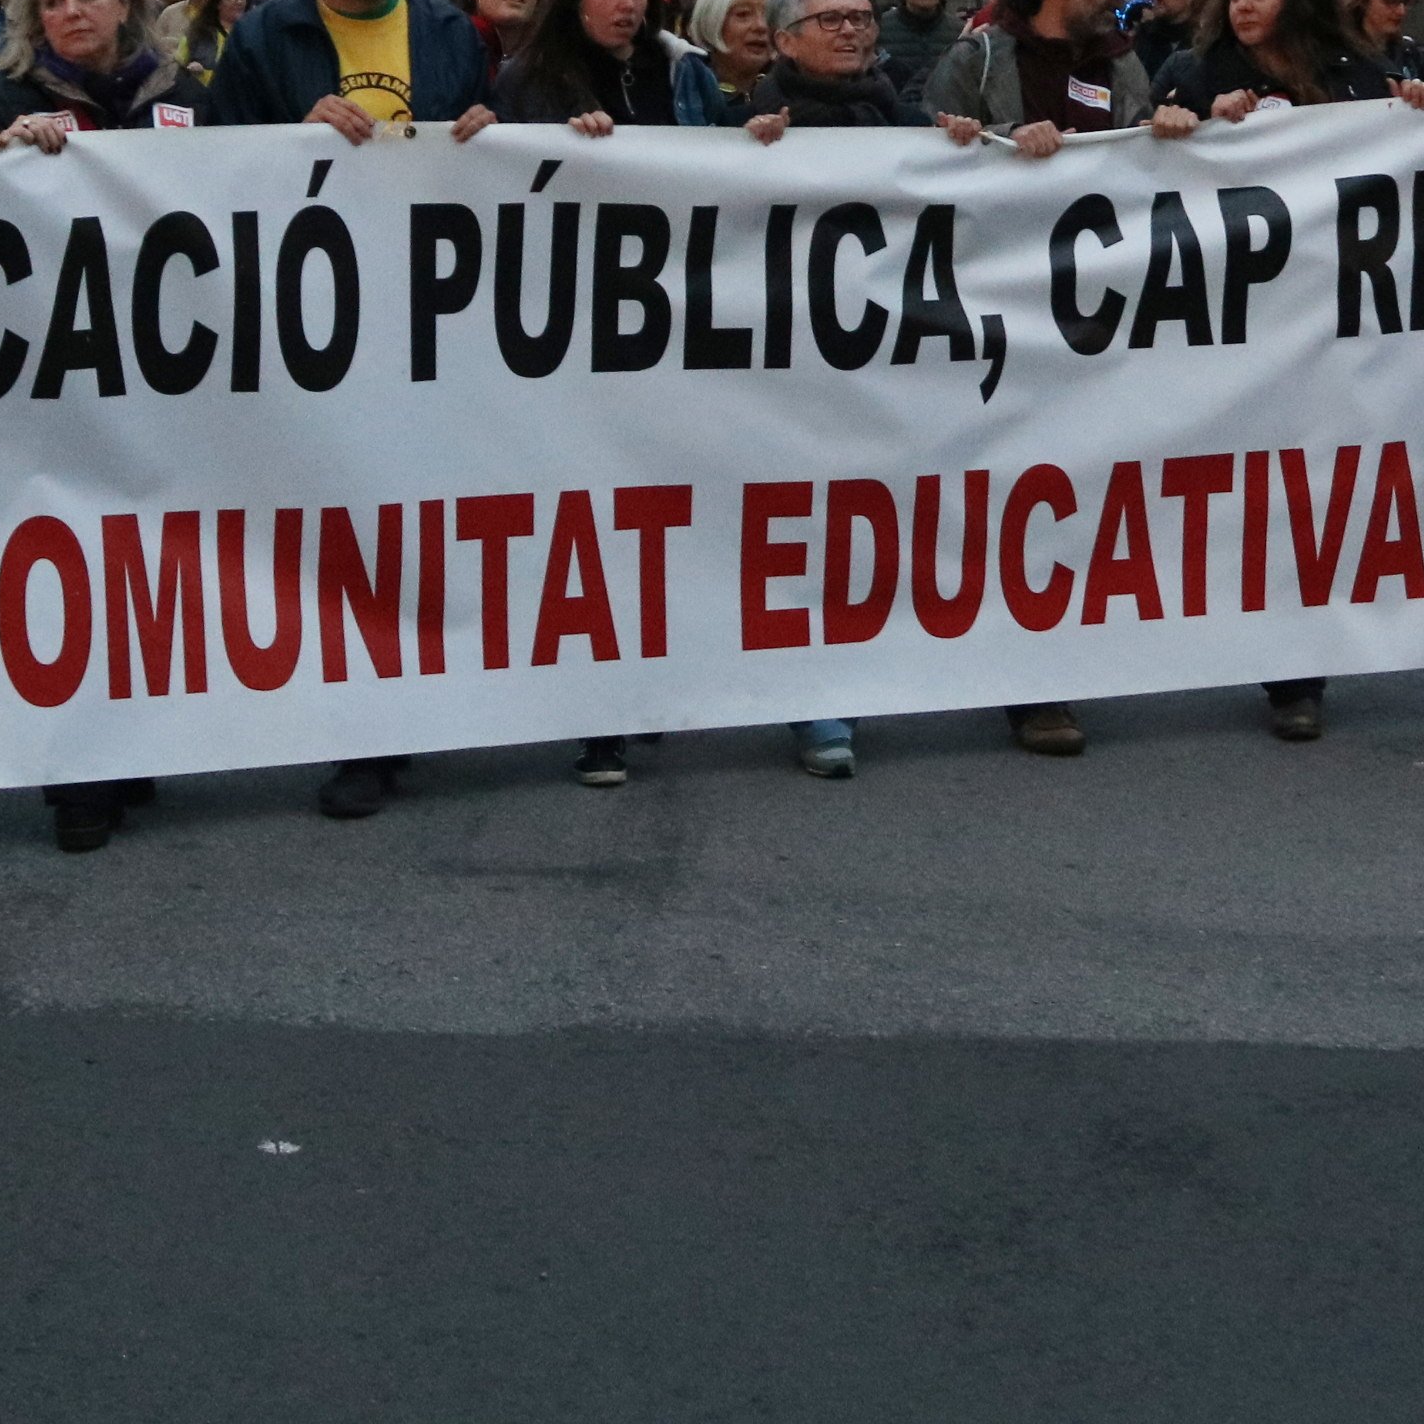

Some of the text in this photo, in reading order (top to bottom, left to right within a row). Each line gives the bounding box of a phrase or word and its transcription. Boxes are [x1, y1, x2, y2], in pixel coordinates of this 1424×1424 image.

[163, 107, 189, 126] UGT
[409, 159, 1007, 405] PÚBLICA,
[1048, 186, 1293, 356] CAP
